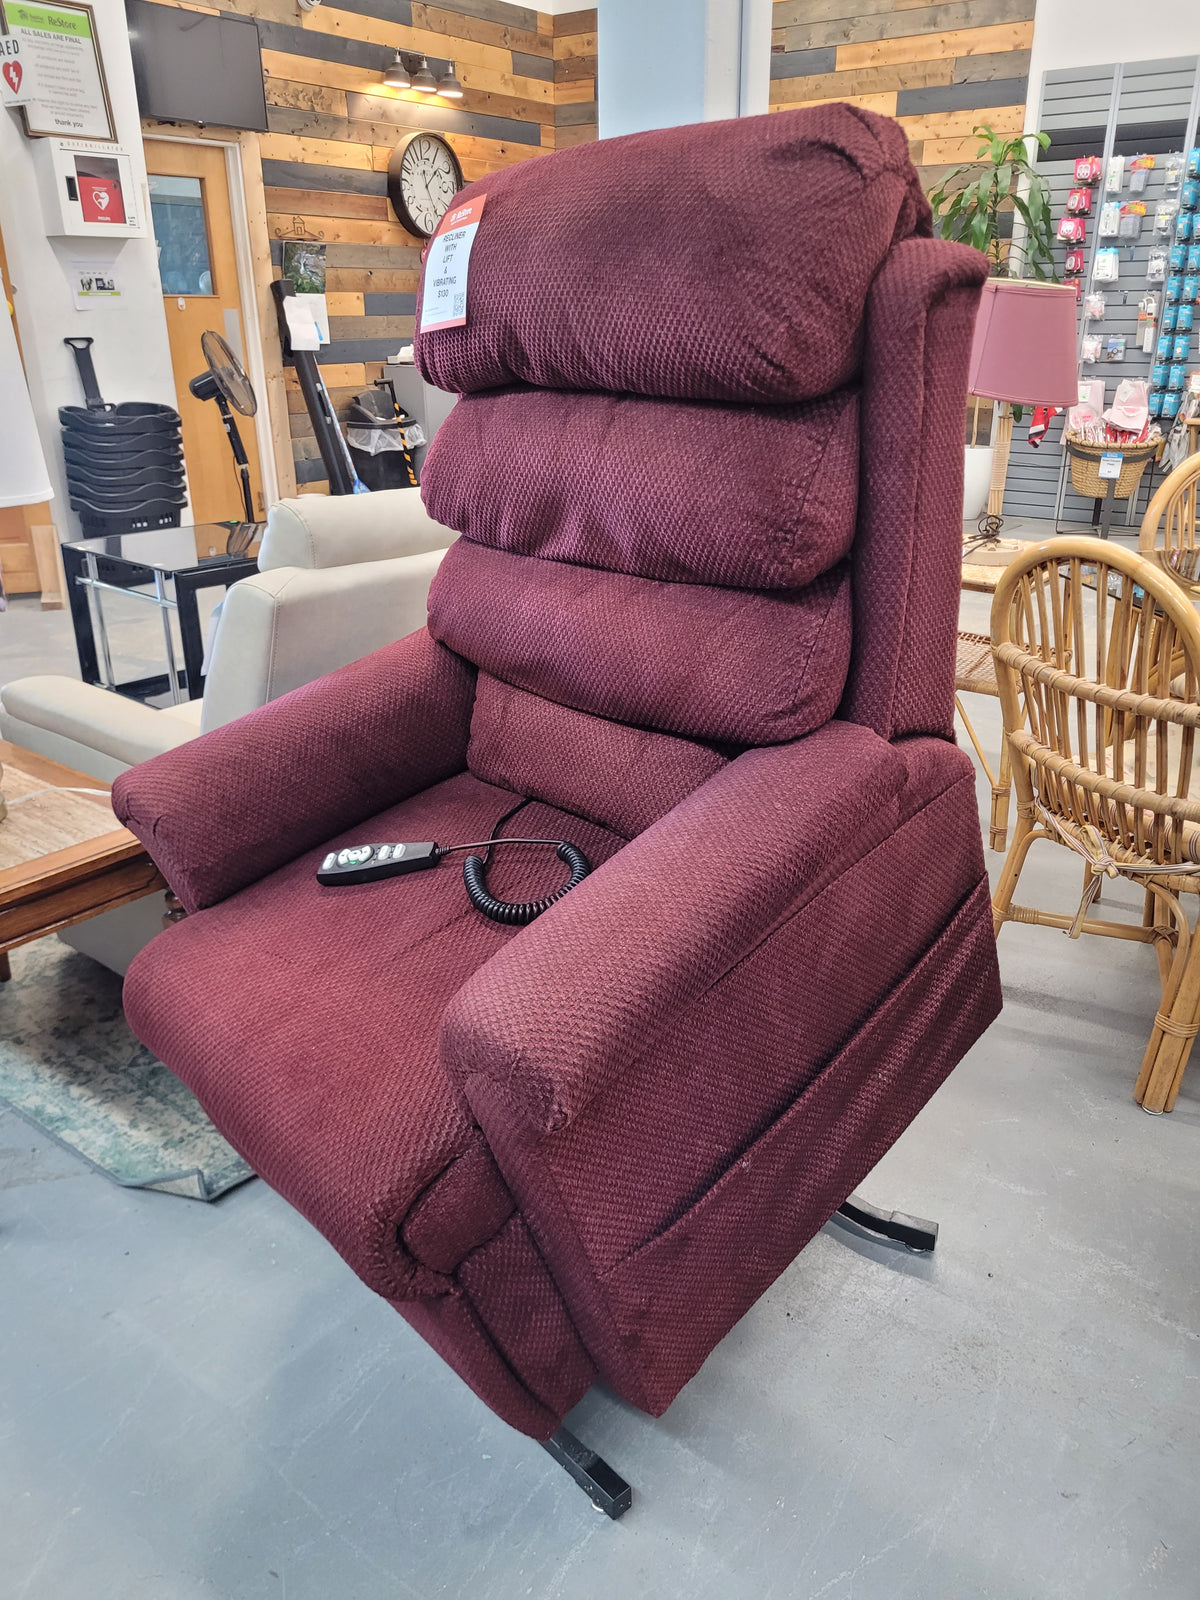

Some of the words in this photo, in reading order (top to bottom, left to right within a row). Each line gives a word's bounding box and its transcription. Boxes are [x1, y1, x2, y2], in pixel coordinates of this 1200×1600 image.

[20, 27, 32, 37] ALL
[33, 29, 52, 39] SALES
[52, 34, 65, 42] ARE
[65, 35, 82, 45] FINAL
[0, 39, 20, 56] AED
[418, 139, 431, 162] 12
[443, 230, 467, 243] RECLINER
[444, 243, 458, 253] WITH
[442, 254, 454, 264] LIFT
